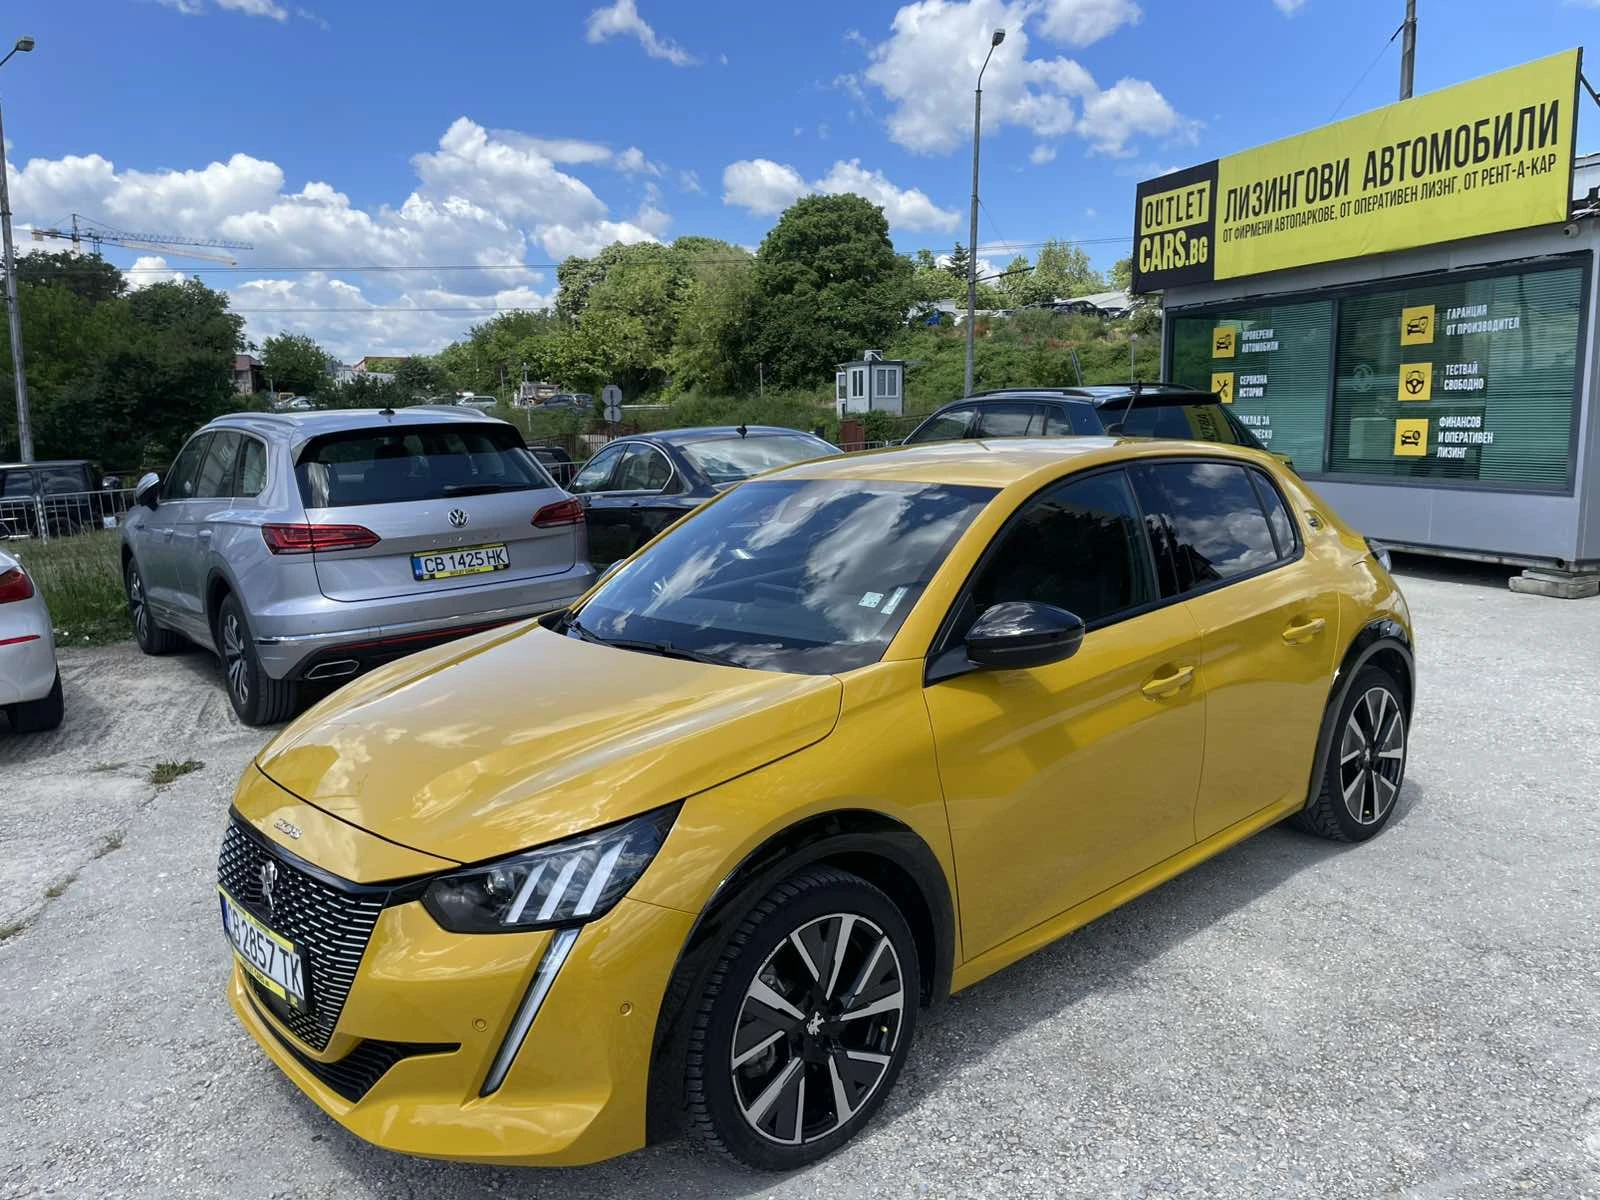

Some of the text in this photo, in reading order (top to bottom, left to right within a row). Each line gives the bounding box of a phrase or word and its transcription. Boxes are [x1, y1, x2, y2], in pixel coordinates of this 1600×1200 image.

[1224, 99, 1559, 224] ЛИЗИНГОВИ АВТОМОБИЛИ
[1145, 187, 1206, 229] OUTLET
[1223, 227, 1233, 243] ОТ
[1234, 218, 1273, 240] ФИРМЕНИ
[1340, 201, 1352, 218] ОТ
[1354, 184, 1418, 215] ОПЕРАТИВЕН
[1464, 170, 1479, 191] ОТ
[1481, 153, 1557, 187] РЕНТ-А-КАР
[1139, 230, 1209, 274] CARS.BG
[1446, 304, 1488, 320] ГАРАНЦИЯ
[1446, 316, 1520, 336] ОТ ПРОИЗВОДИТЕЛ
[1445, 361, 1478, 376] ТЕСТВАЙ
[1443, 378, 1484, 391] СВОБОДНО
[1438, 416, 1481, 428] ФИНАНСОВ
[1438, 431, 1494, 444] И ОПЕРАТИВЕН
[1436, 446, 1467, 459] ЛИЗИНГ
[424, 556, 446, 573] CB
[449, 551, 485, 570] 1425
[486, 548, 505, 566] HK
[242, 919, 275, 975] 2857
[279, 947, 304, 996] TK
